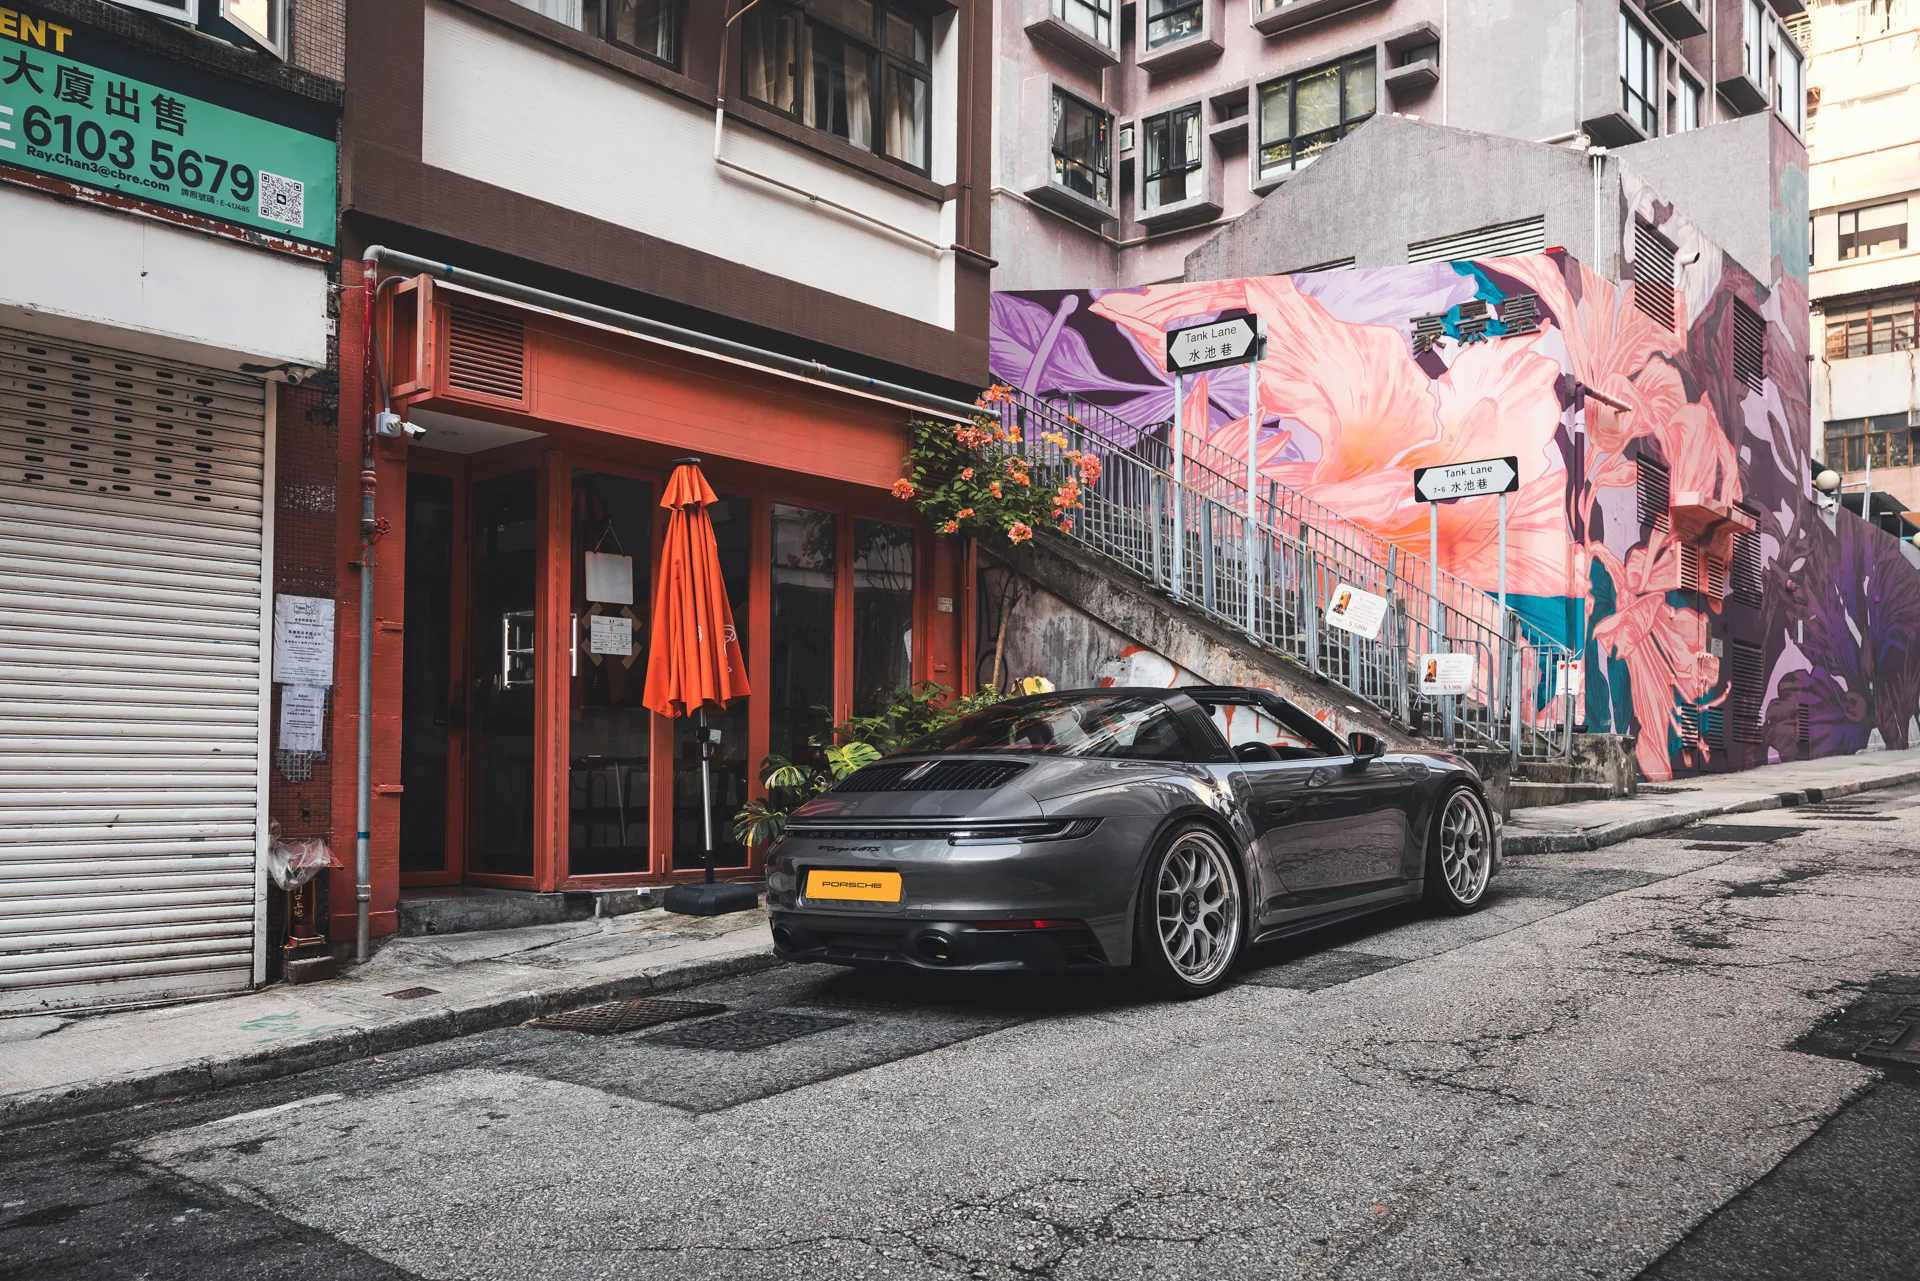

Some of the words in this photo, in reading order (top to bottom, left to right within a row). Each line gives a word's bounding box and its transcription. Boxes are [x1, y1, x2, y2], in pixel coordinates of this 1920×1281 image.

[2, 50, 187, 136] 大廈出售
[23, 105, 135, 170] 6103
[150, 140, 255, 202] 5679
[26, 145, 170, 193] Ray.Chan3@cbre.com
[220, 200, 250, 213] E-417485
[1409, 293, 1541, 355] 豪景臺
[1185, 330, 1208, 344] Tank
[1211, 326, 1237, 339] Lane
[1188, 343, 1232, 362] 水池巷
[1445, 468, 1467, 478] Tank
[1470, 465, 1493, 475] Lane
[1451, 478, 1488, 493] 水池巷
[822, 881, 882, 889] PORSCHE
